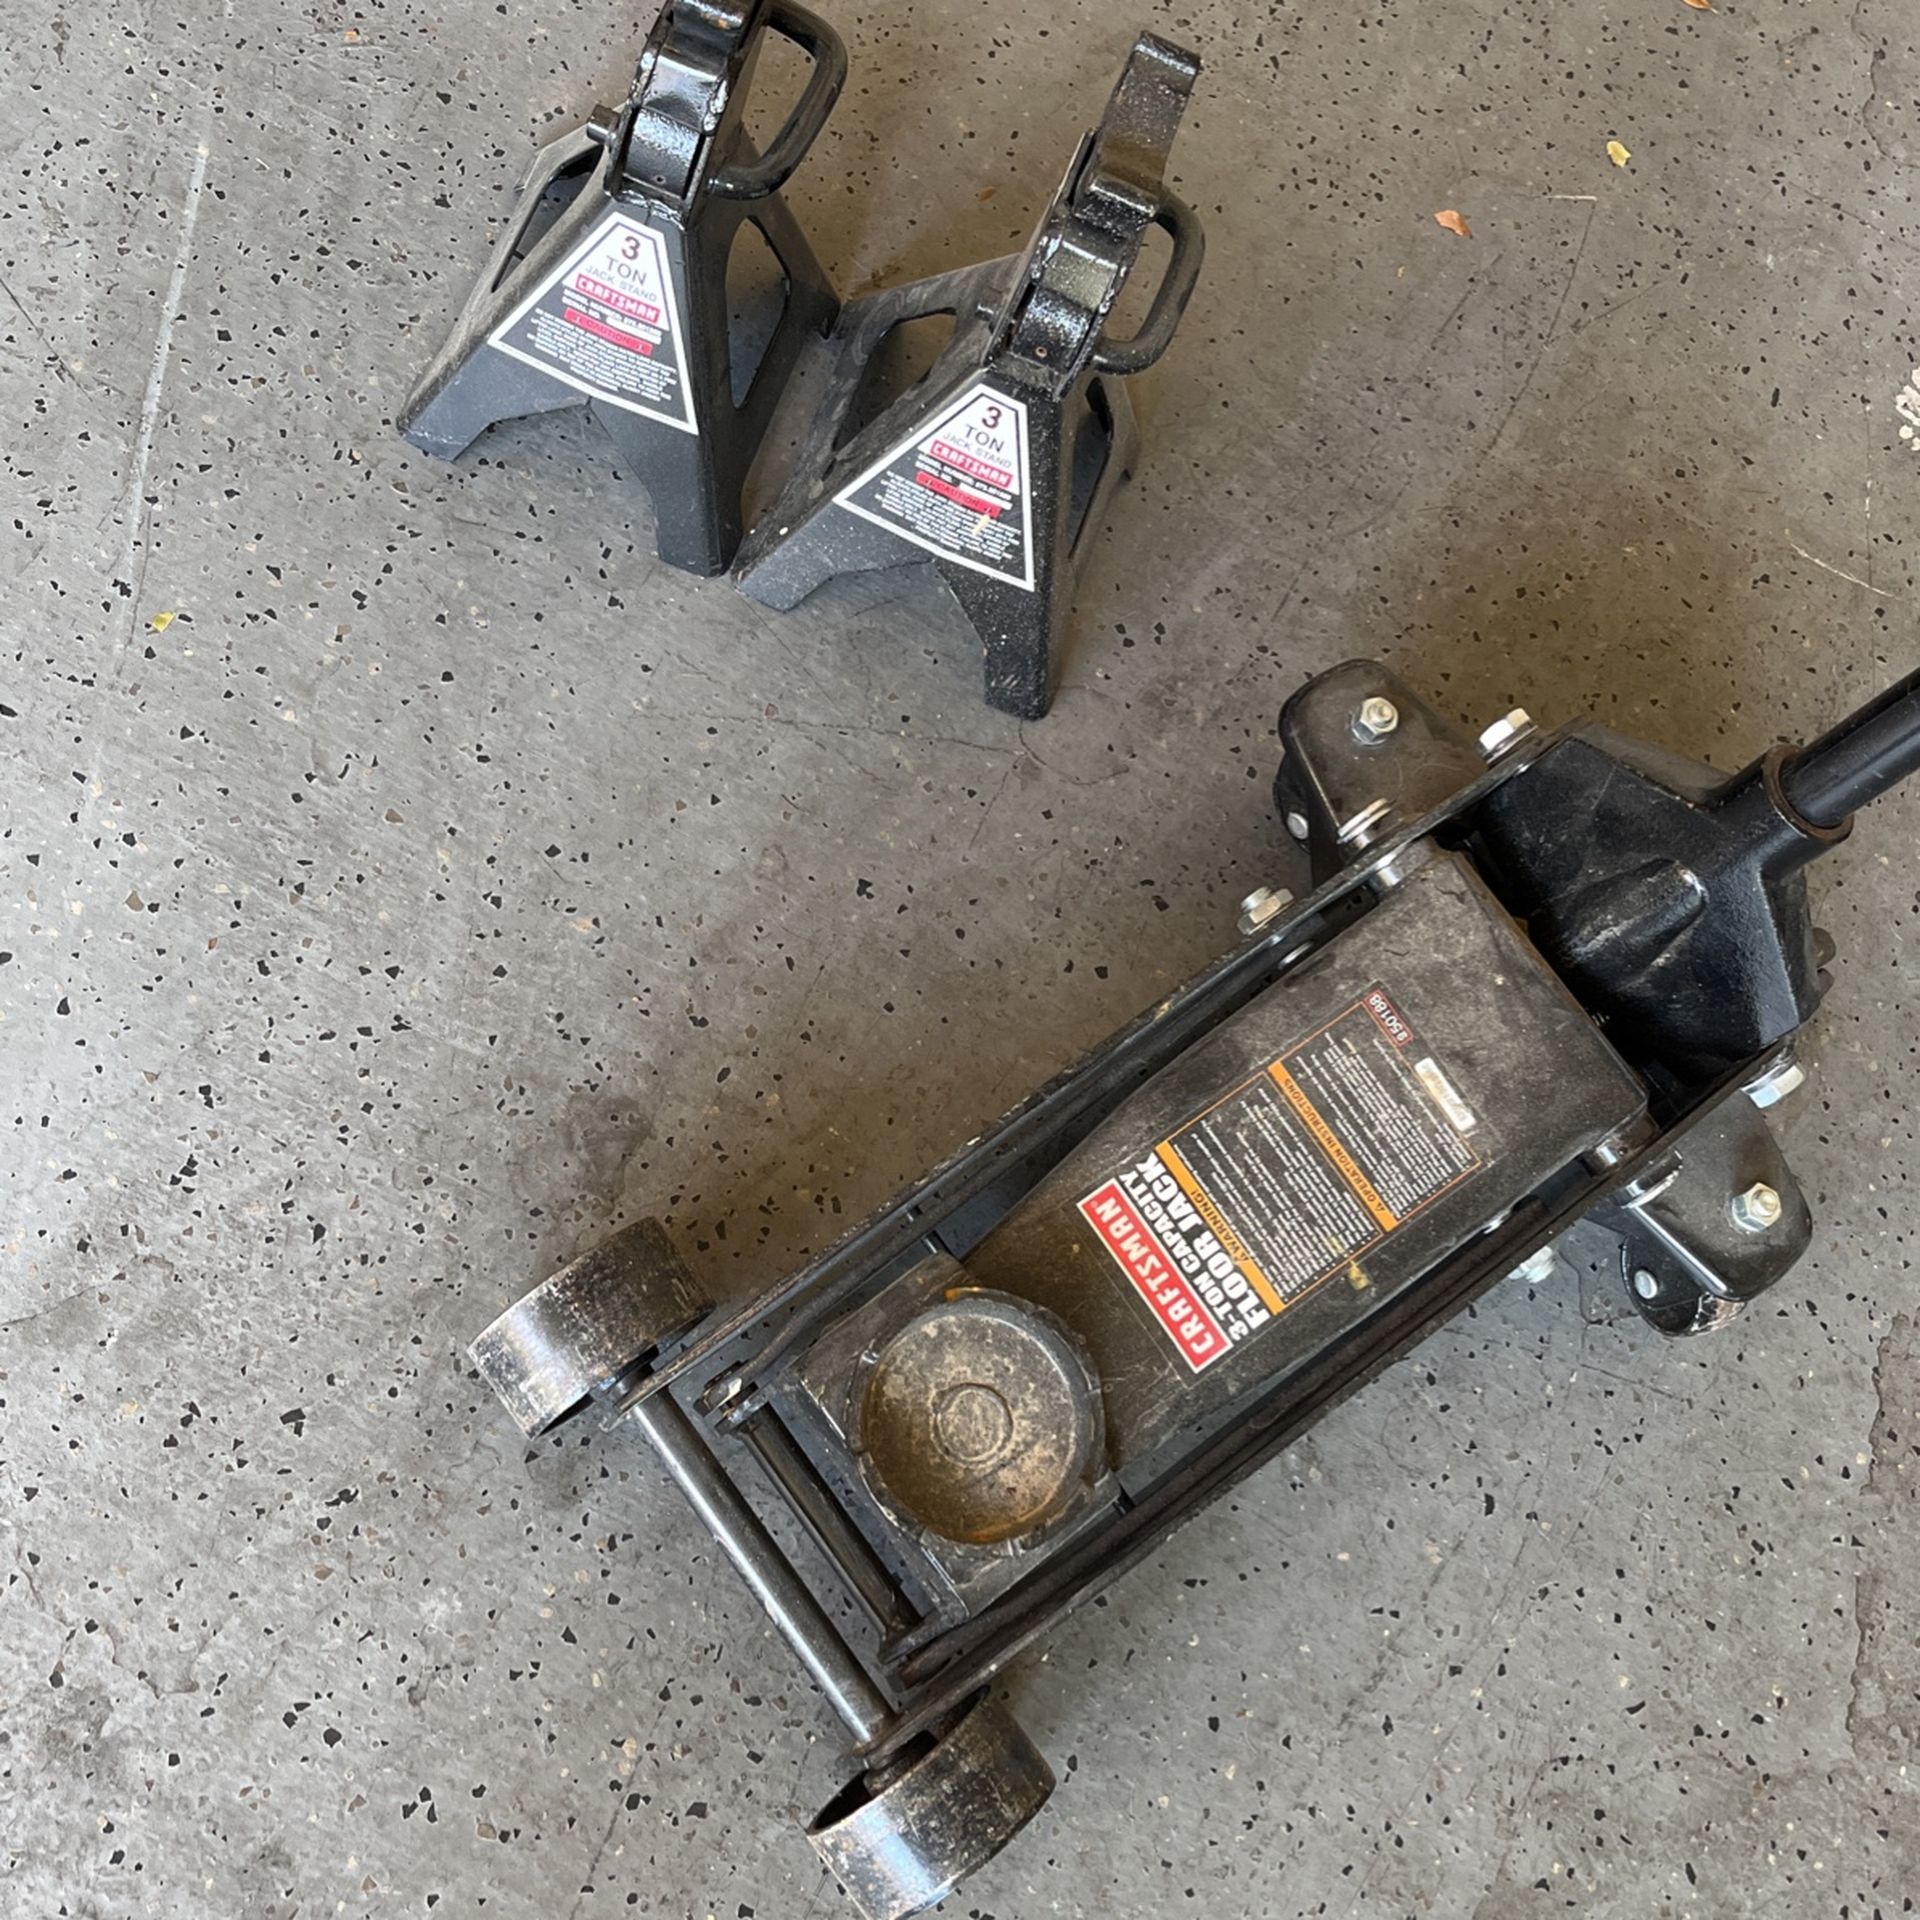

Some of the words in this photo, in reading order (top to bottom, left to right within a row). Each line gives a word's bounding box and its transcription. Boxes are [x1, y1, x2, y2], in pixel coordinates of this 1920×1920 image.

[622, 236, 641, 260] 3
[585, 265, 615, 284] JACK
[619, 281, 657, 302] STAND
[606, 255, 647, 286] TON
[578, 277, 658, 323] CRAFTSMAN
[587, 319, 630, 344] CAUTION
[965, 424, 1005, 452] TON
[982, 406, 1001, 429] 3
[933, 443, 1010, 486] CRAFTSMAN
[943, 432, 971, 451] JACK
[976, 447, 1012, 468] STAND
[939, 483, 980, 506] CAUTION
[1281, 1077, 1337, 1149] INSTRUCTIONS
[1134, 1150, 1204, 1233] JACK
[1332, 1146, 1377, 1203] OPERATION
[1117, 1166, 1202, 1275] CAPACITY
[1189, 1187, 1239, 1254] WARNING!
[1092, 1194, 1217, 1356] CRAFTSMAN
[1189, 1228, 1271, 1330] FLOOR
[1191, 1269, 1251, 1342] 3-TON
